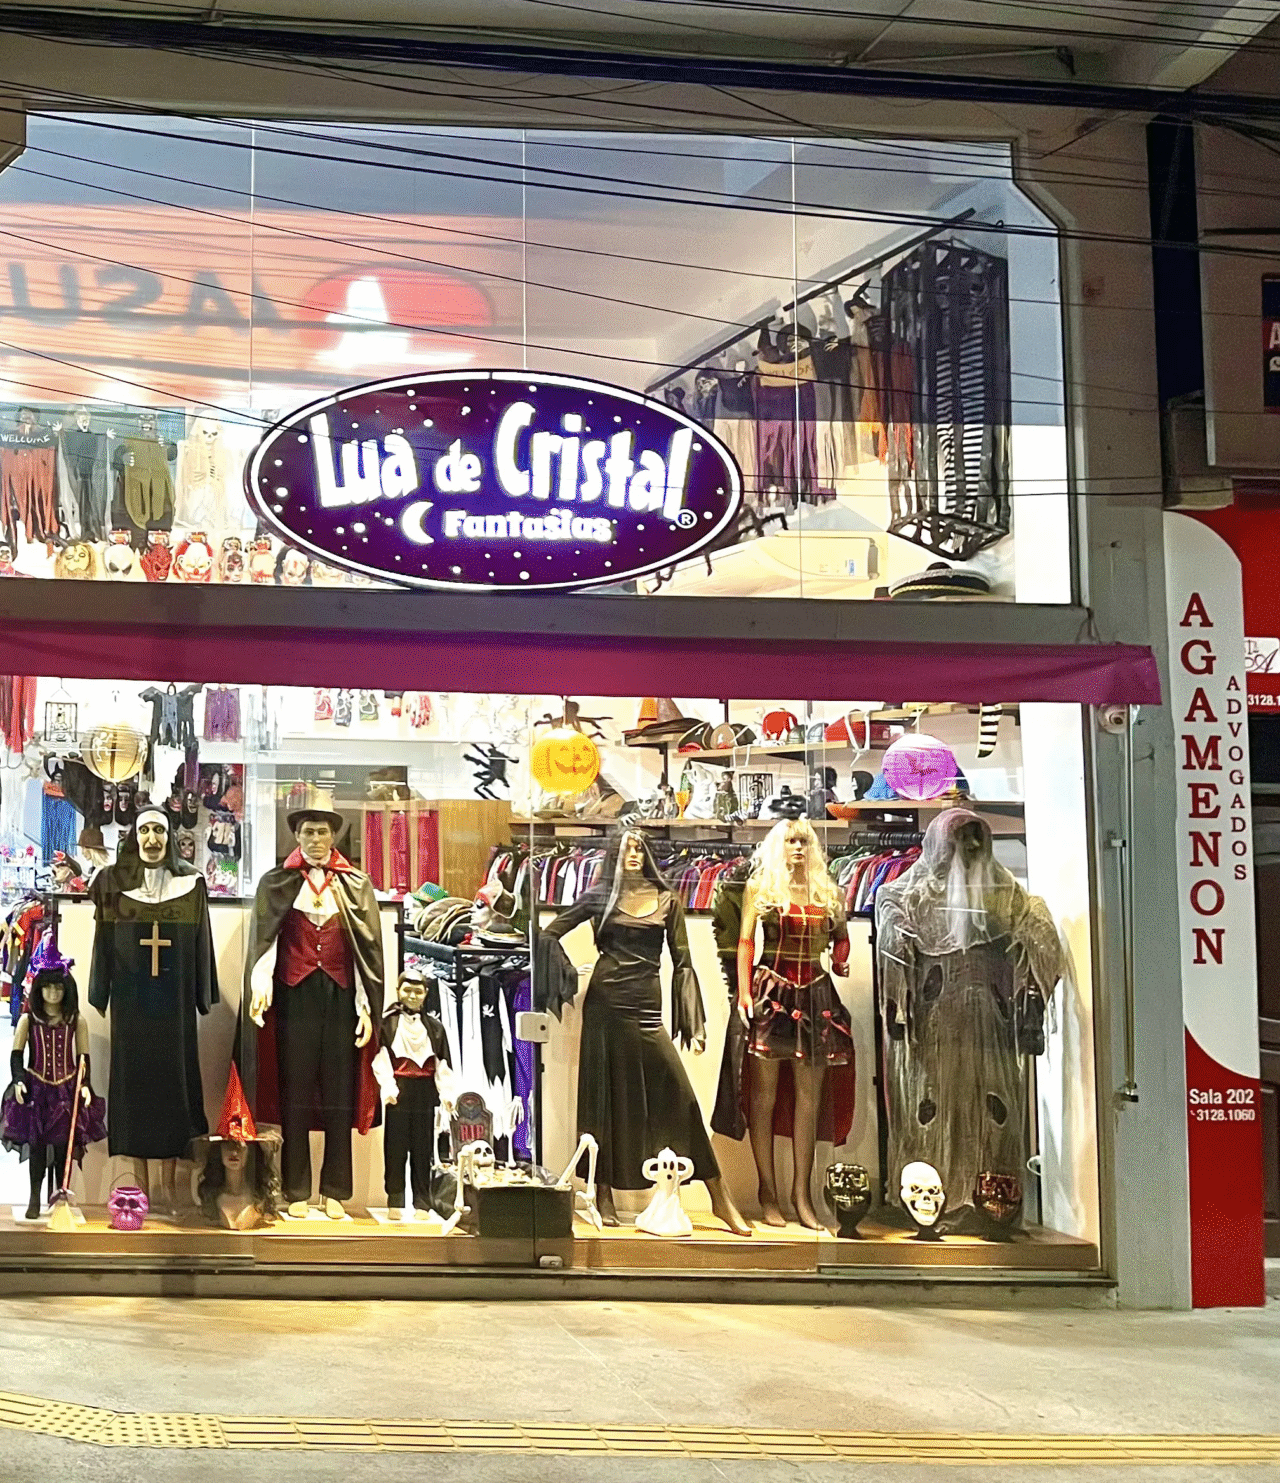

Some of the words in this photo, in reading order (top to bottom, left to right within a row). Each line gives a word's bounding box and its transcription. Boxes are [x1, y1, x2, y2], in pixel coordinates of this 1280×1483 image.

[309, 412, 418, 508] Lua
[435, 438, 481, 493] de
[495, 401, 693, 519] Cristal
[445, 508, 612, 542] Fantasias
[1180, 592, 1226, 965] AGAMENON
[1226, 675, 1247, 881] ADVOGADOS
[1189, 1088, 1223, 1105] Sala
[1226, 1088, 1255, 1105] 202
[1196, 1108, 1256, 1121] 3128.1060
[460, 1124, 485, 1141] RIP
